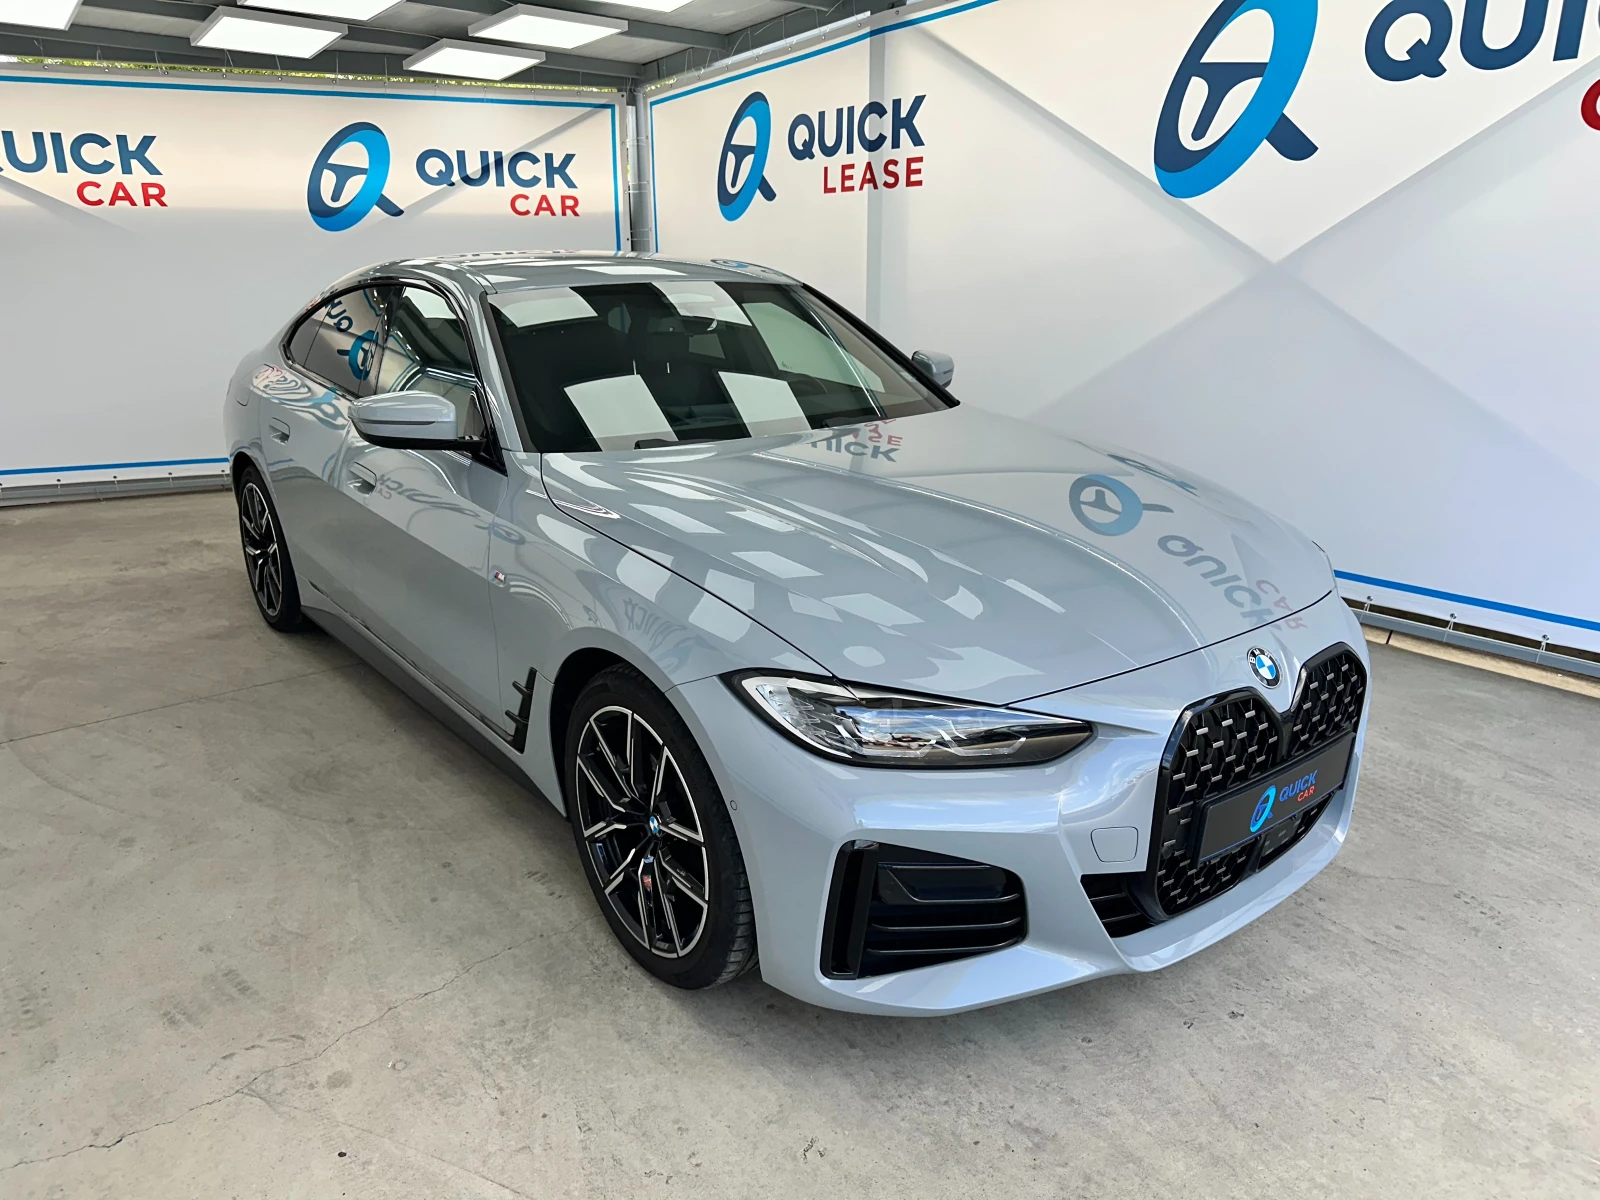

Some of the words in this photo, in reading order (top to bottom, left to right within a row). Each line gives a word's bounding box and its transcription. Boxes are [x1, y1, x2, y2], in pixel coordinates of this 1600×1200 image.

[1365, 0, 1600, 82] QUI
[787, 94, 927, 161] QUICK
[0, 130, 163, 176] UICK
[416, 148, 578, 189] QUICK
[76, 181, 168, 207] CAR
[823, 156, 924, 194] LEASE
[510, 194, 580, 217] CAR
[1279, 769, 1319, 802] QUICK
[1297, 785, 1315, 802] CAR
